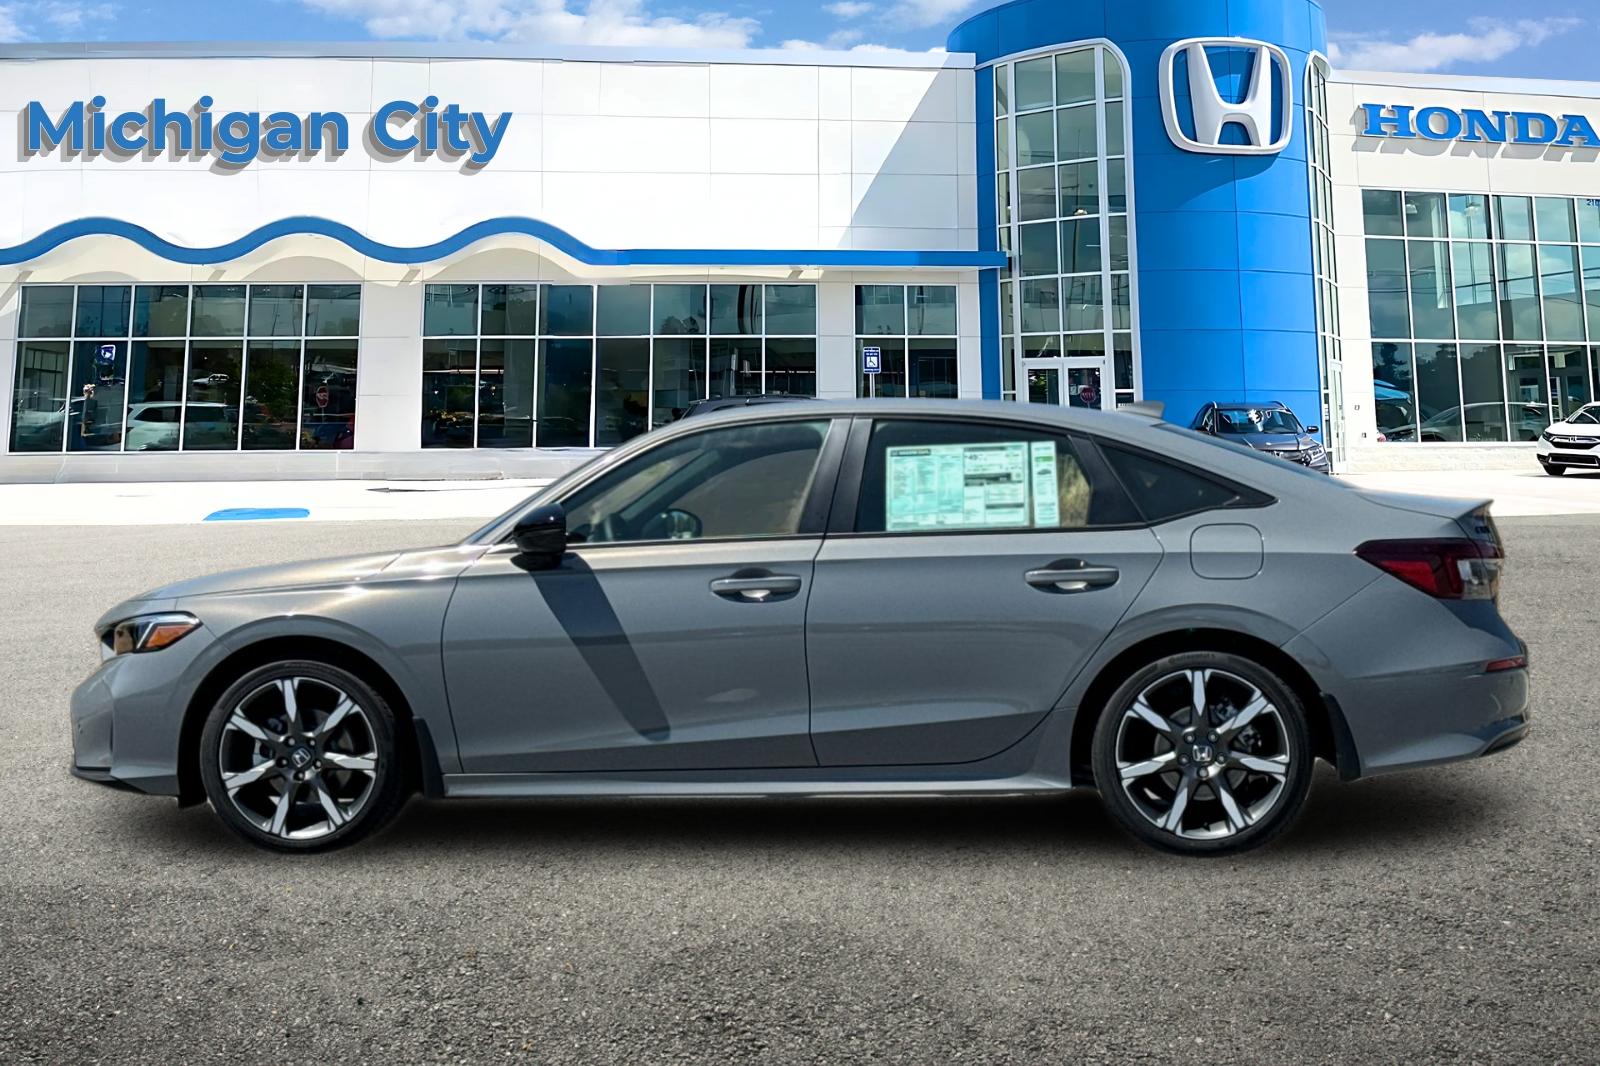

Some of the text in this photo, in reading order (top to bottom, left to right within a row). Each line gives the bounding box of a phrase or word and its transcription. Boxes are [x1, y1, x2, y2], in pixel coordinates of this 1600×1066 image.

[28, 95, 513, 164] Michigan City
[1362, 103, 1600, 148] HONDA
